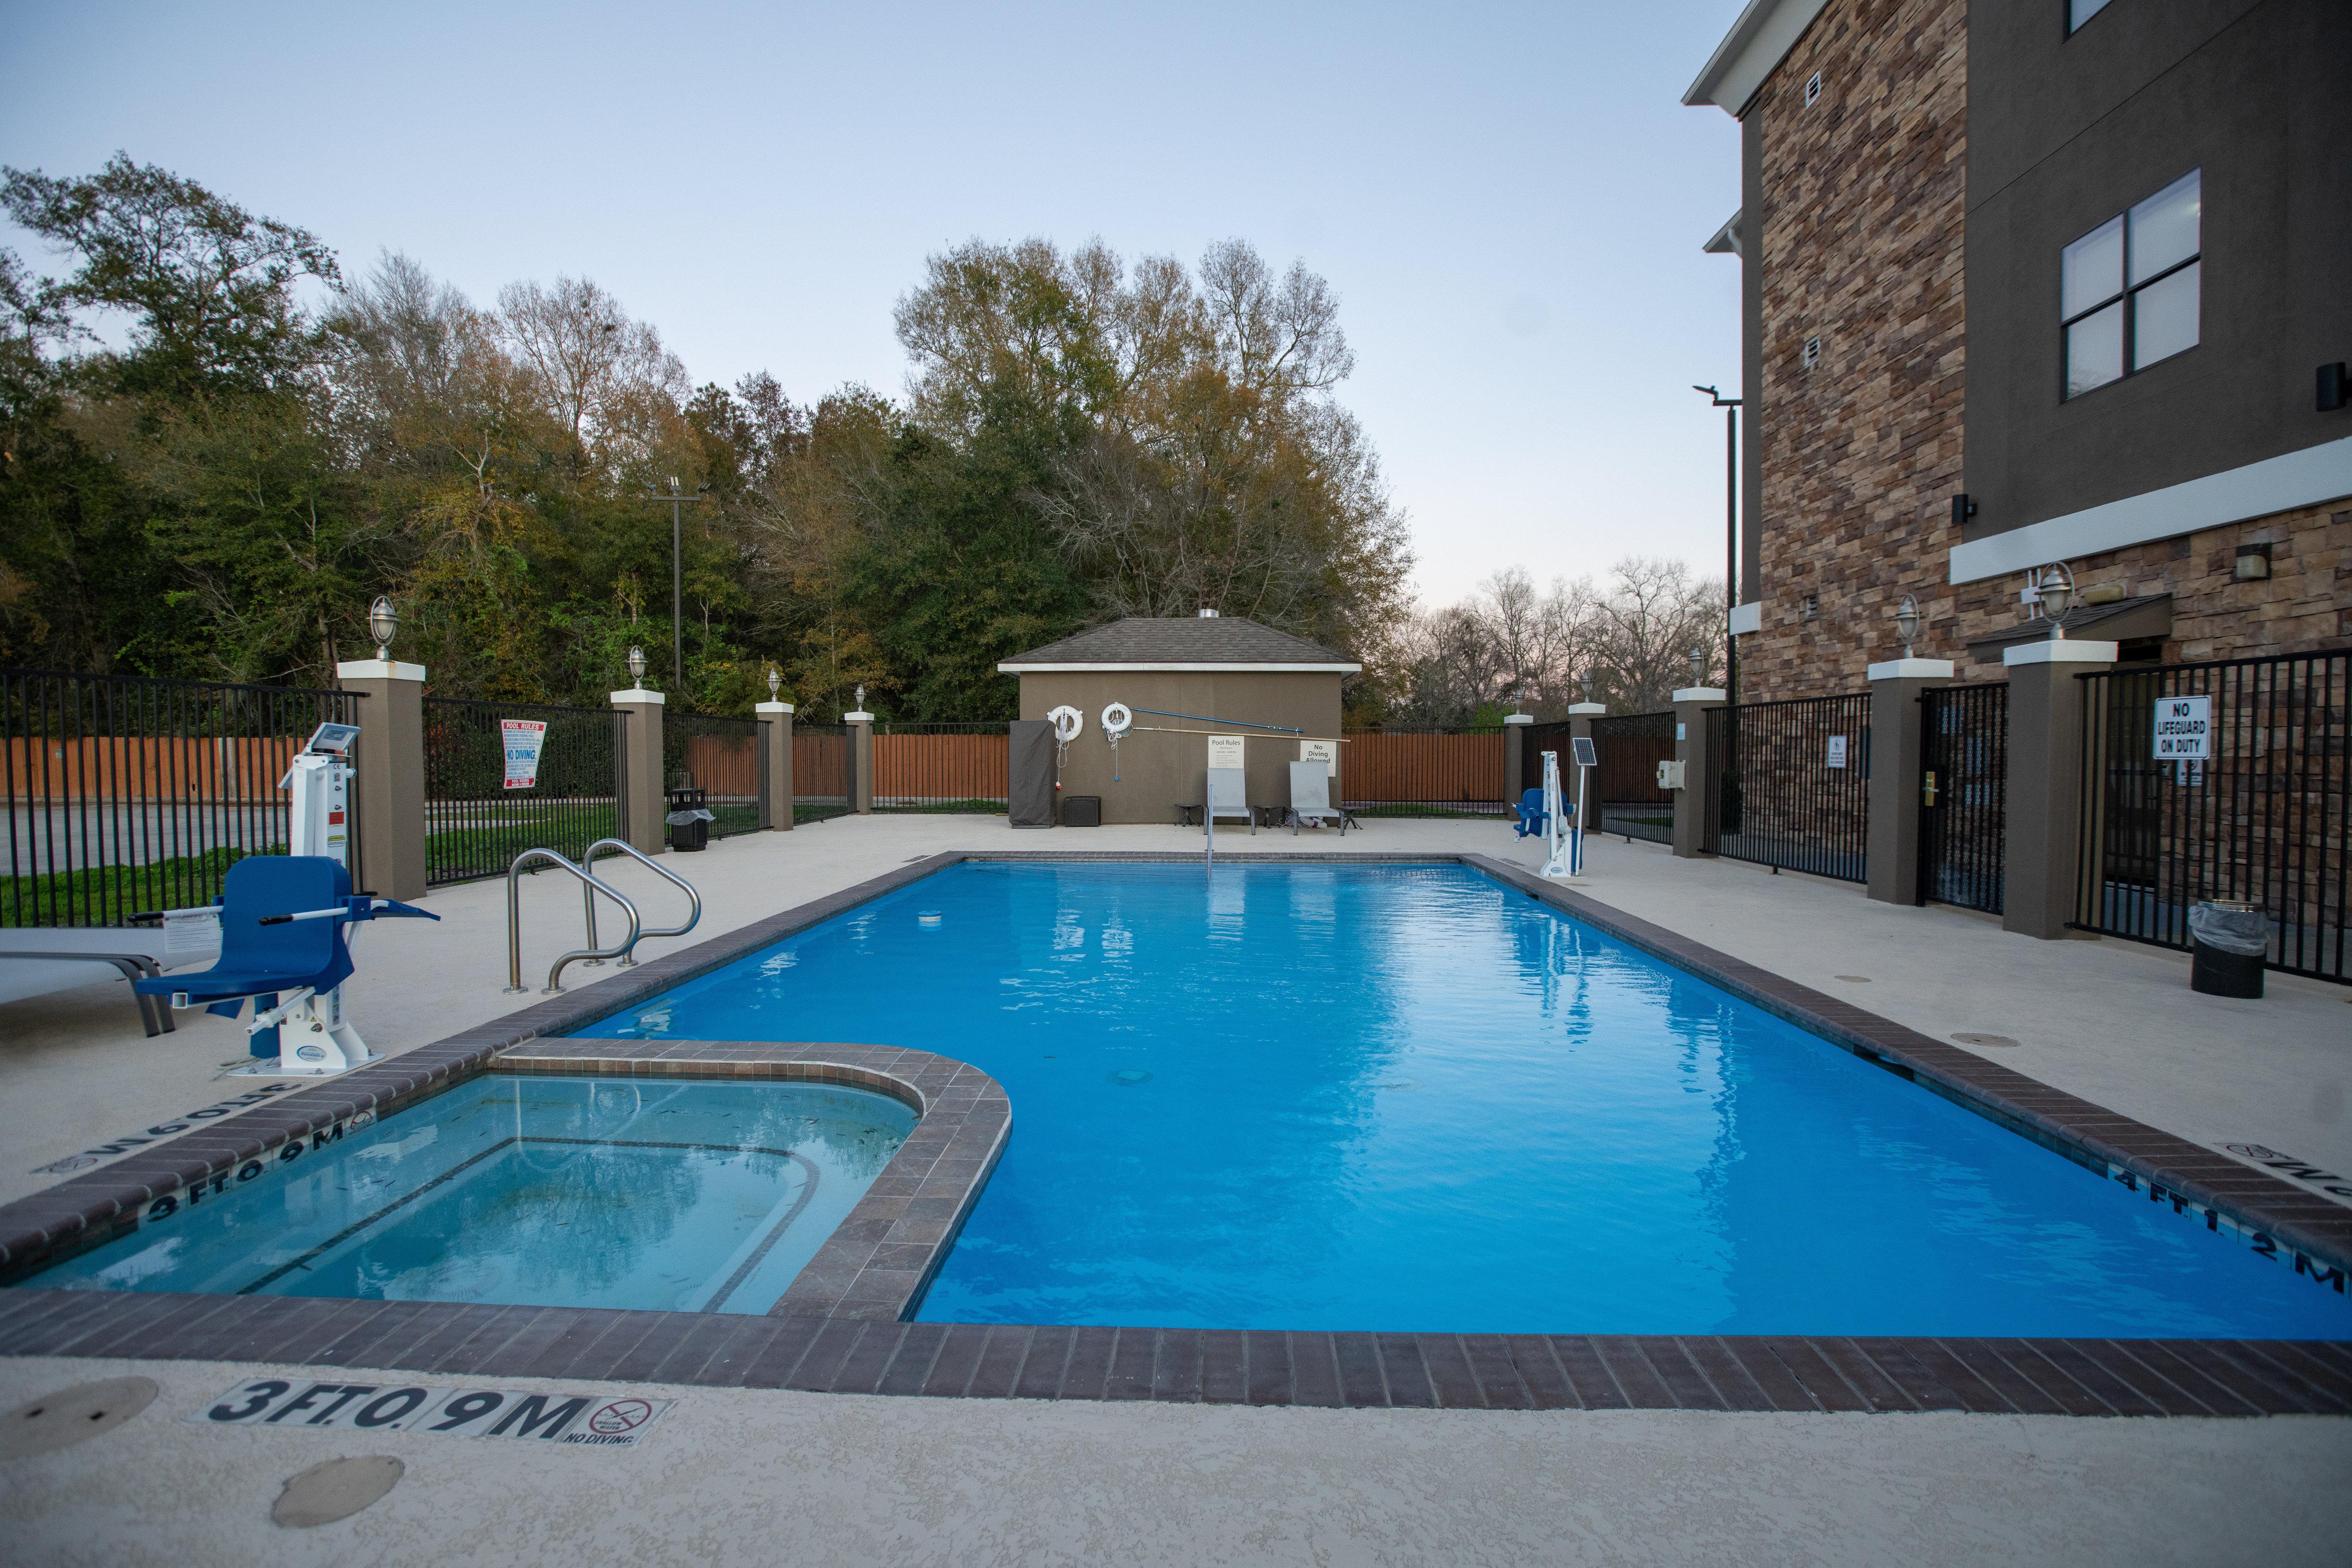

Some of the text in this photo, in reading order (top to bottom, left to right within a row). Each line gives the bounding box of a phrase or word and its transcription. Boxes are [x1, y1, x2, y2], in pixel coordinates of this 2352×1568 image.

[2173, 703, 2190, 716] NO
[2158, 721, 2206, 735] LIFEGUARD
[2161, 739, 2201, 752] ON DUTY
[507, 750, 513, 760] NO
[564, 1433, 634, 1444] NO DIVING
